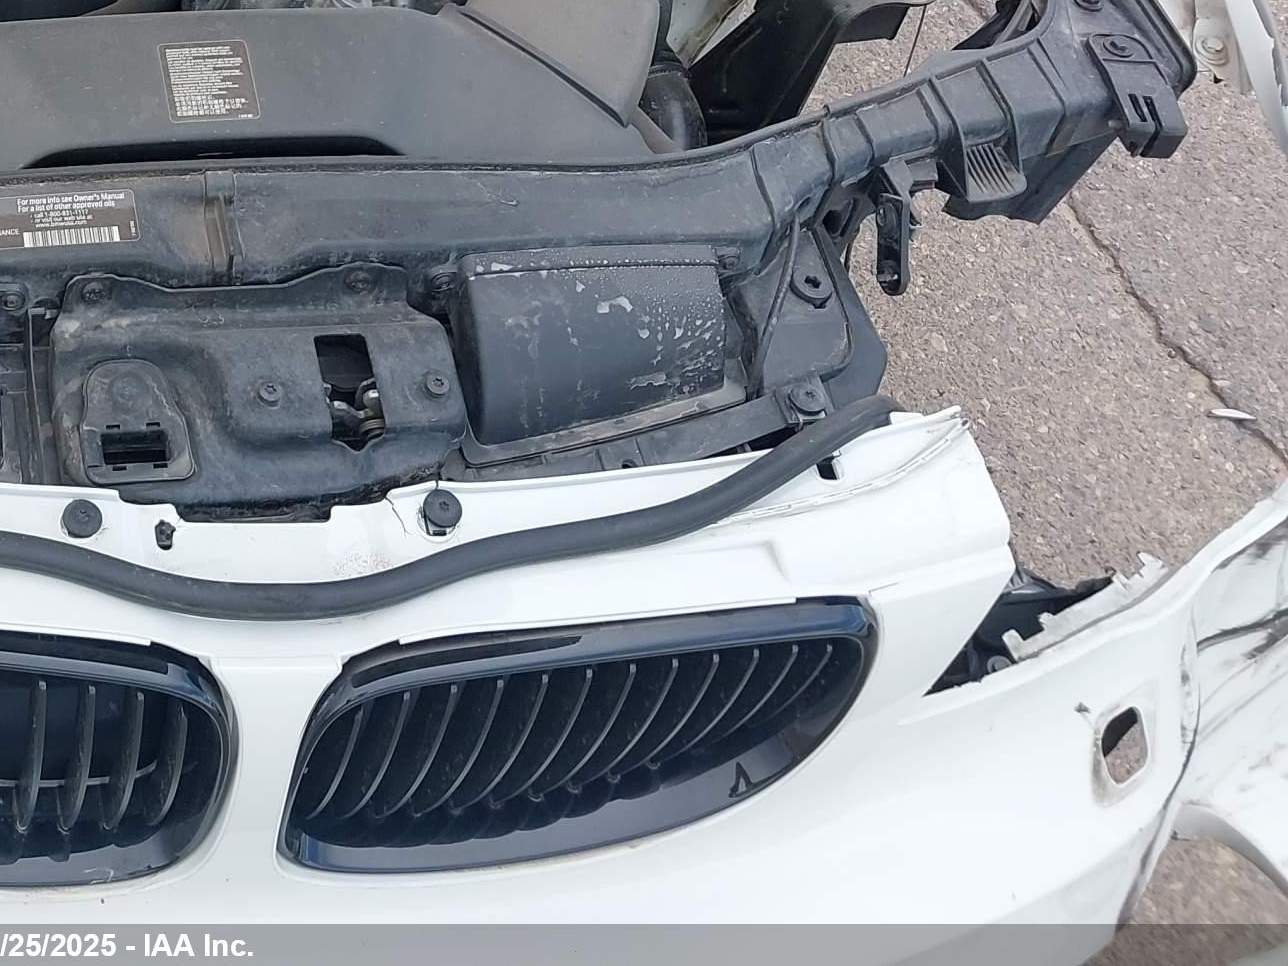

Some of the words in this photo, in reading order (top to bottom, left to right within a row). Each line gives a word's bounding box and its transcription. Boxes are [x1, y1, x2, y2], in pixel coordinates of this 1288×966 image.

[17, 198, 28, 206] For
[47, 196, 60, 204] info
[73, 193, 100, 202] Owner's
[101, 192, 125, 200] Manual
[17, 205, 29, 213] For
[35, 204, 45, 212] list
[46, 203, 53, 211] of
[54, 202, 71, 210] other
[72, 200, 103, 210] approved
